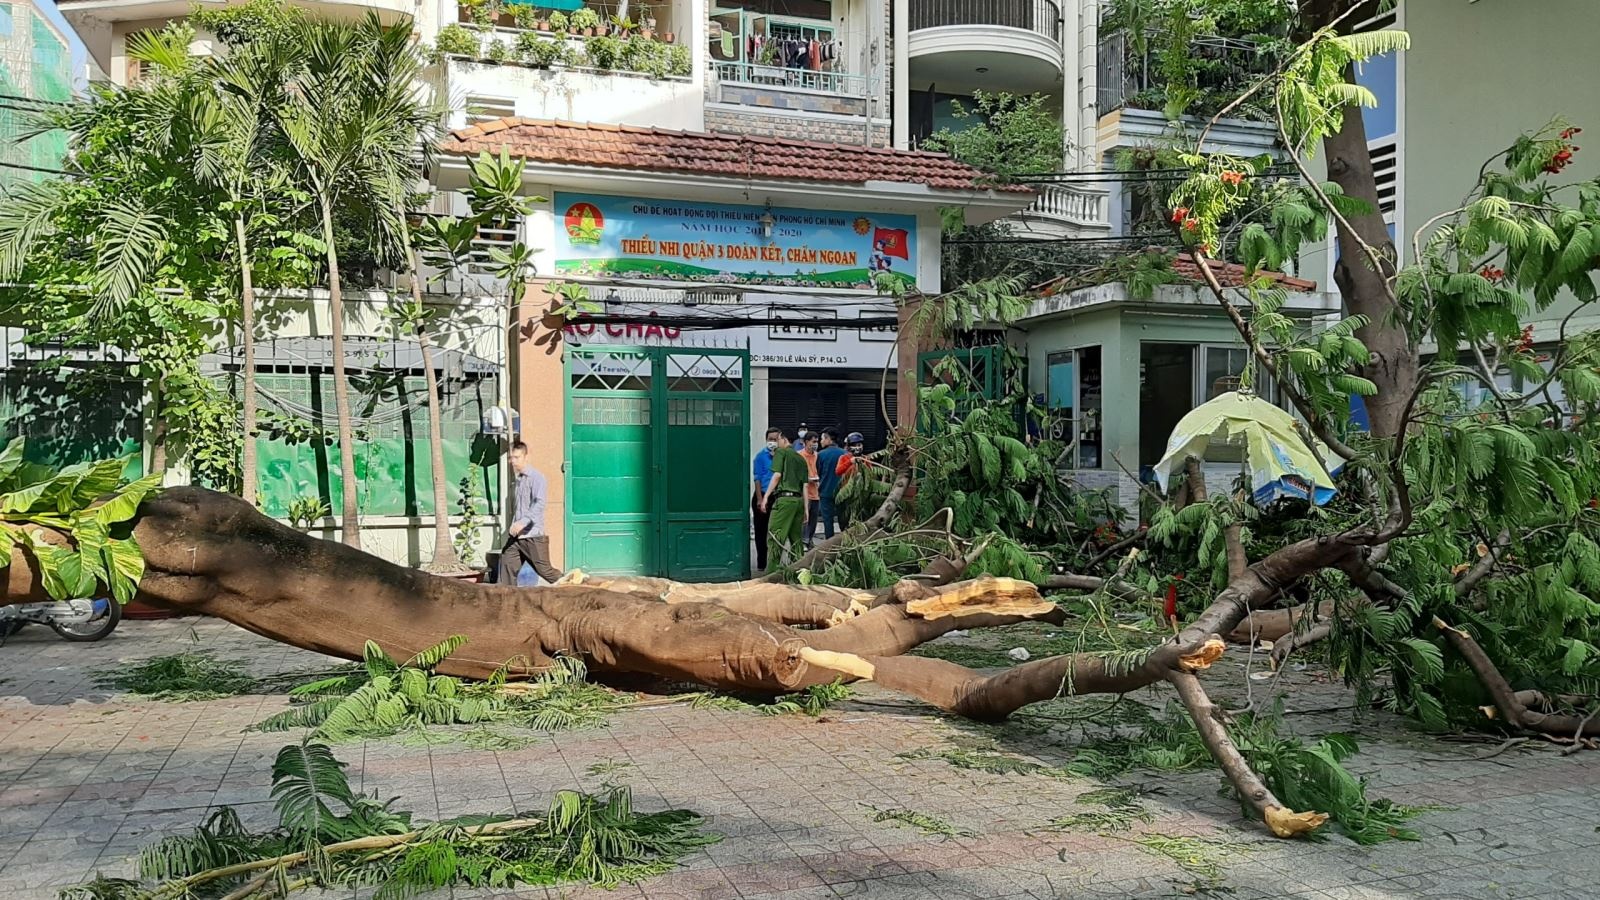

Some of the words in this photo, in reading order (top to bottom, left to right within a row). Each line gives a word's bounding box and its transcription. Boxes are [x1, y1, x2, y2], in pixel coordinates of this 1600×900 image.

[659, 241, 680, 257] NHI
[682, 240, 714, 262] QUẬN
[717, 244, 724, 258] 3
[820, 250, 857, 266] NGOAN
